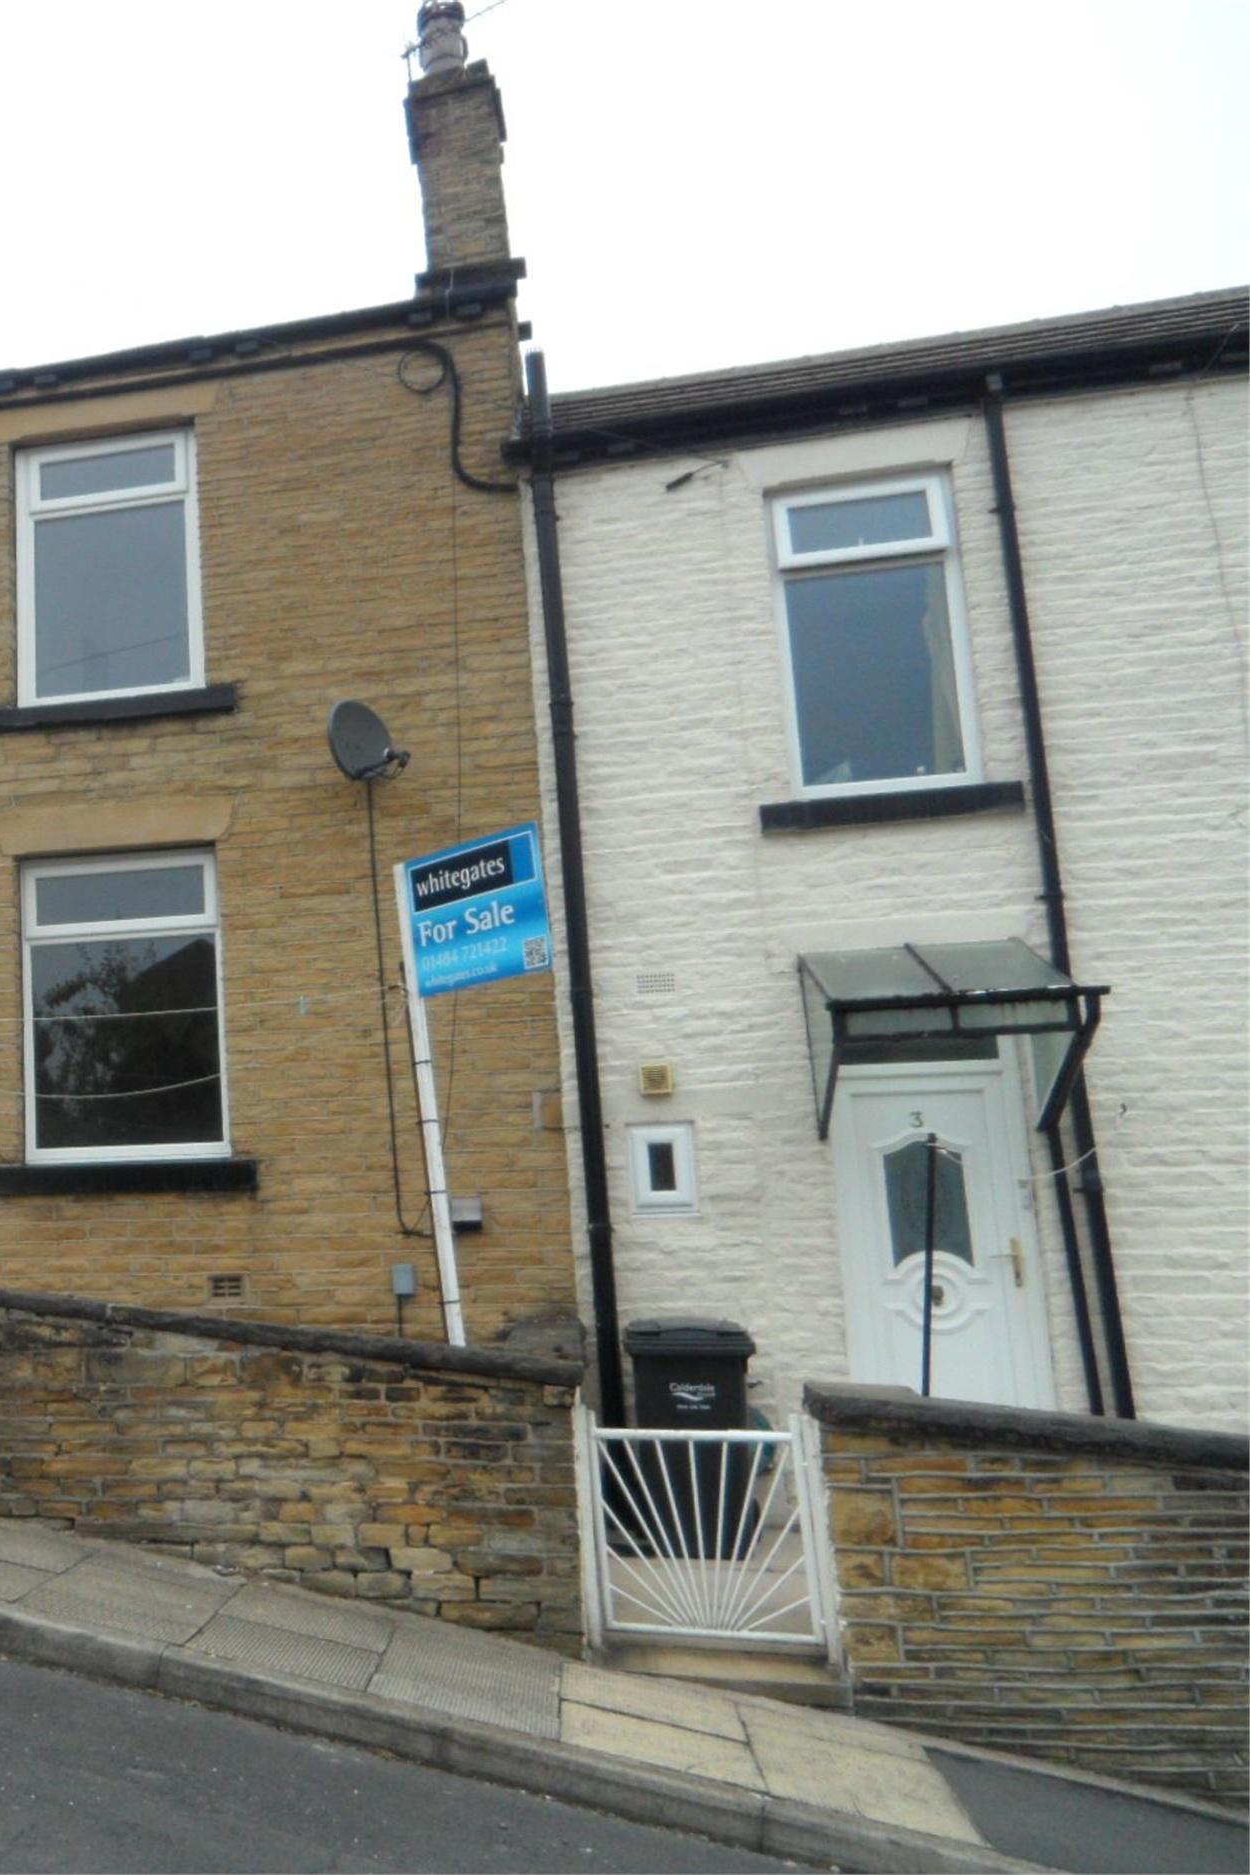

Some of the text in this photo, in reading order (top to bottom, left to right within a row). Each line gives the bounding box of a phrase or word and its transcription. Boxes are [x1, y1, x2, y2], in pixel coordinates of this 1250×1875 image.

[416, 856, 506, 898] whitegates
[416, 900, 515, 947] For Sale
[909, 1111, 924, 1128] 3
